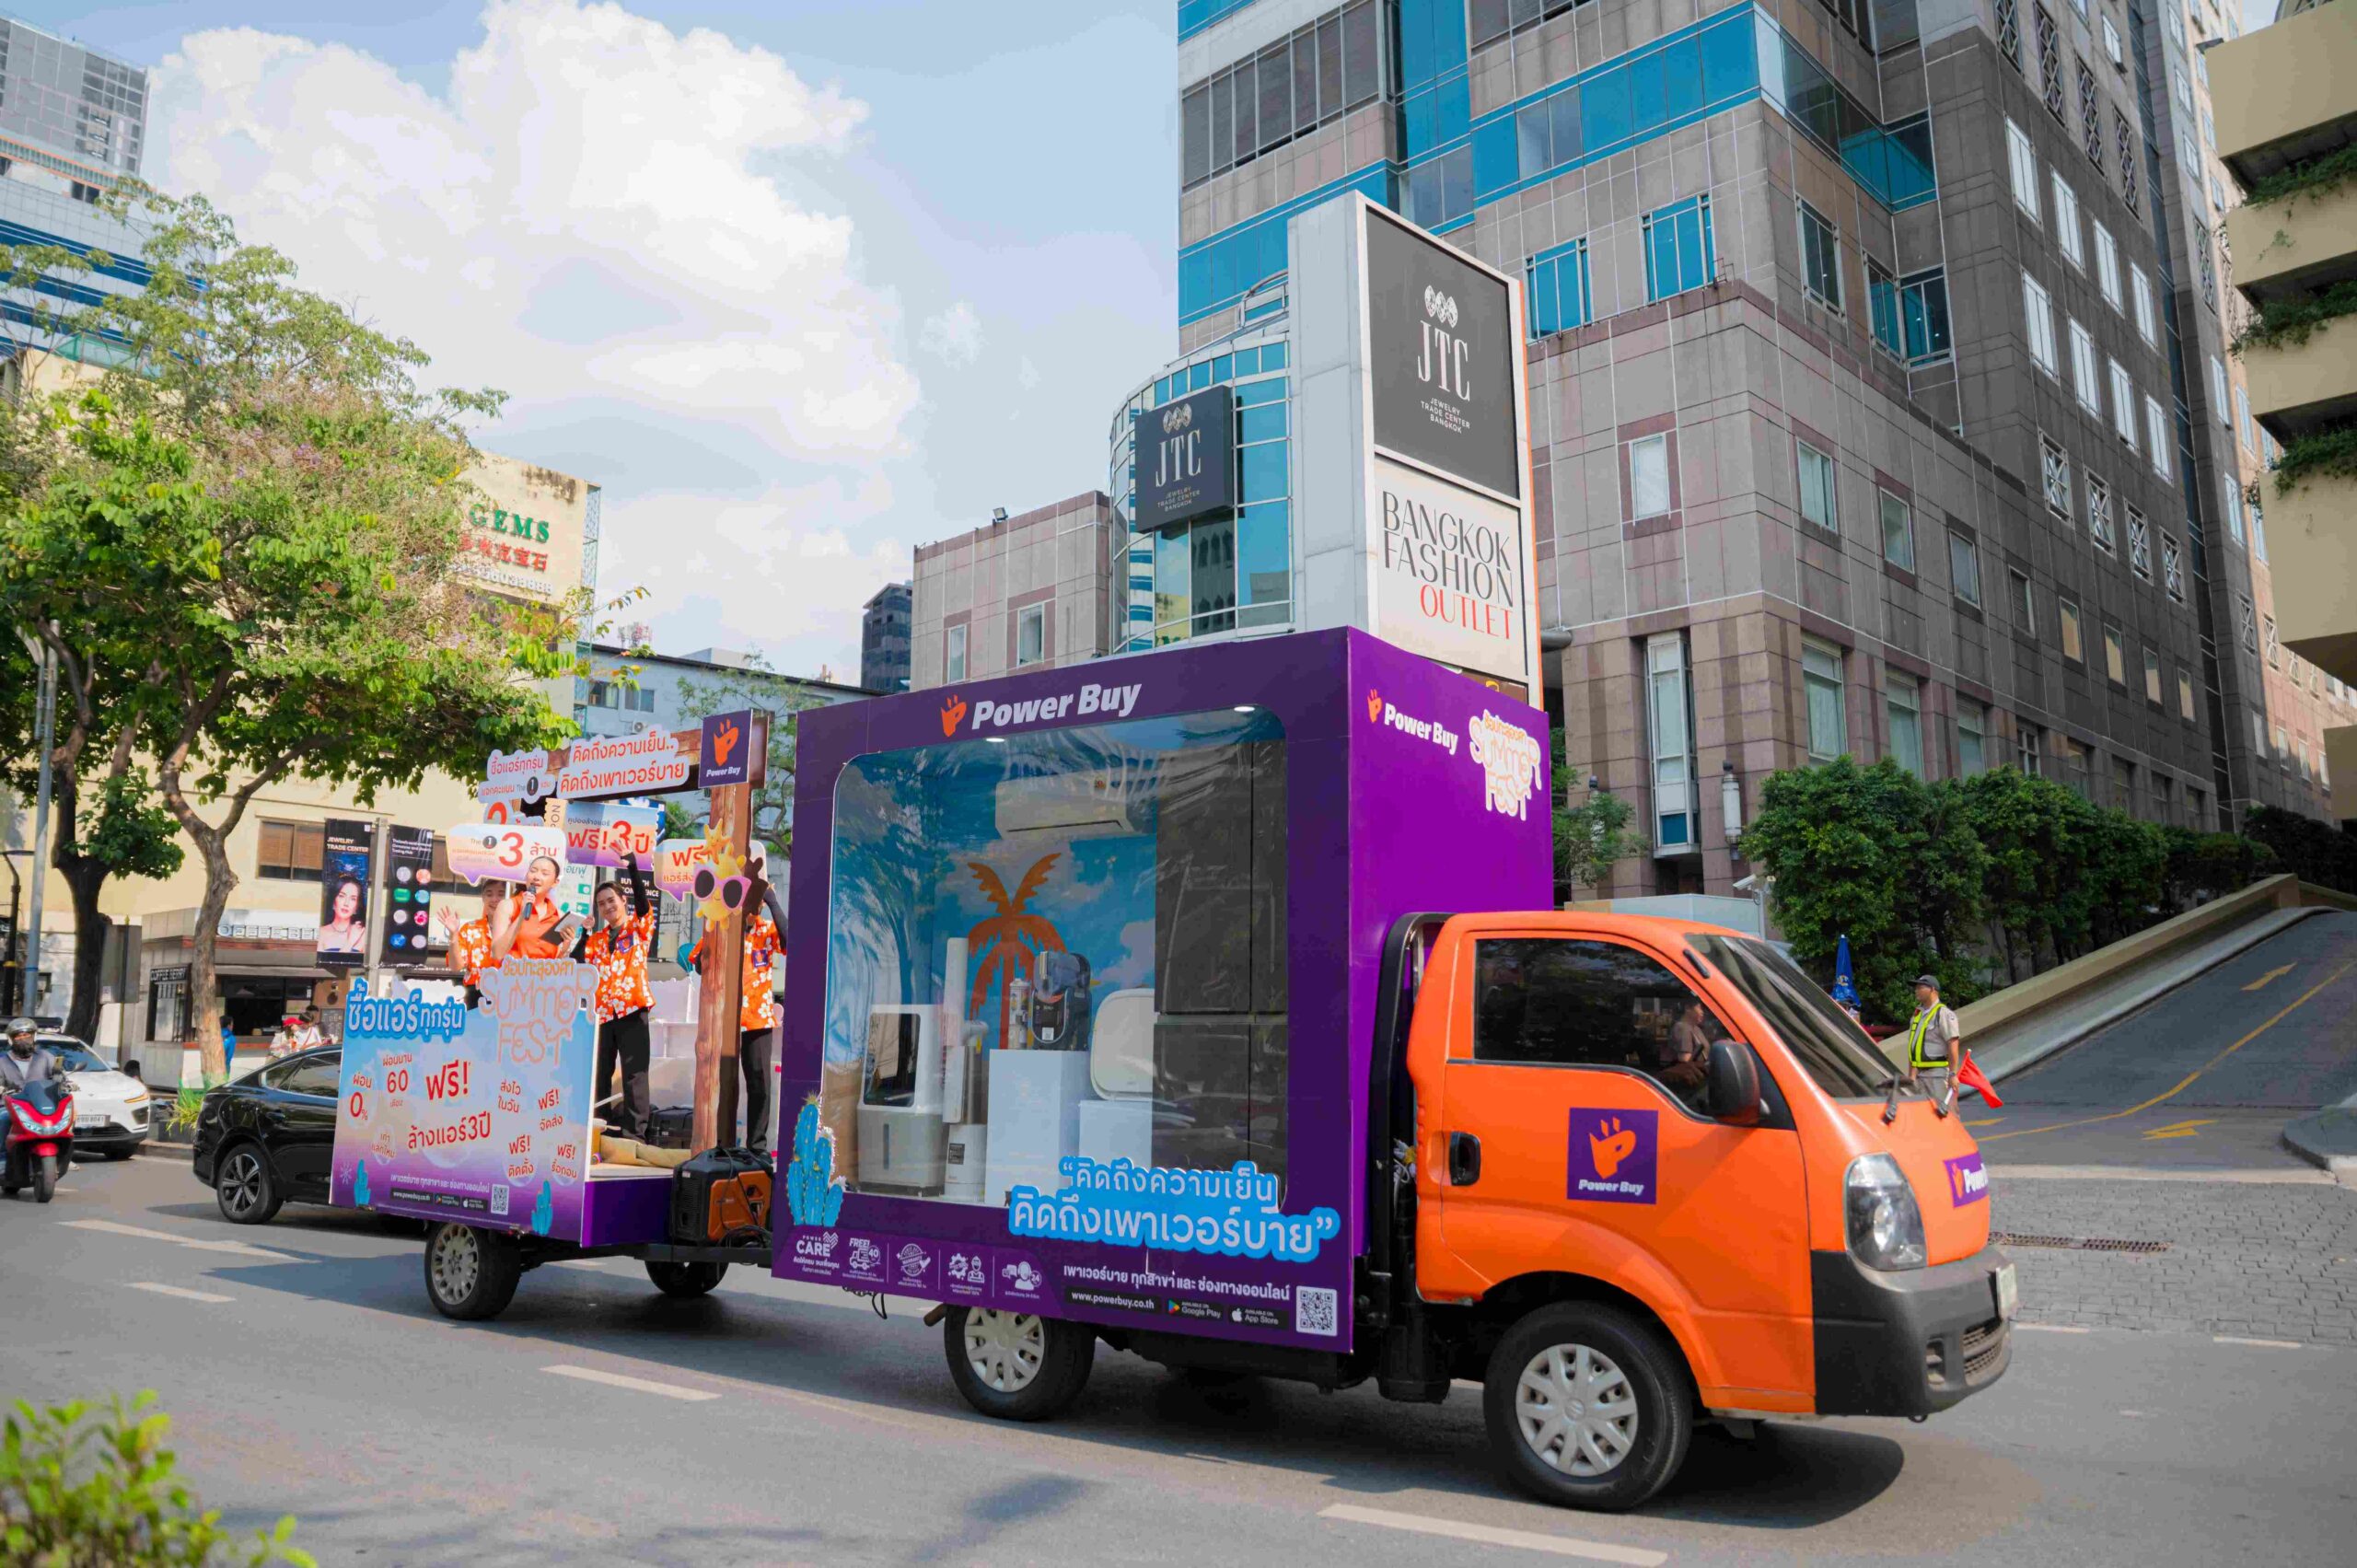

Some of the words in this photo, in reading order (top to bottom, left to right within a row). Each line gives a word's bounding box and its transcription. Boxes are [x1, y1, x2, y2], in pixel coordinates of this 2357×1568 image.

[1418, 319, 1470, 401] JTC
[1421, 401, 1443, 417] TRADE
[1446, 412, 1470, 429] CENTER
[1431, 398, 1460, 415] JEWELRY
[1430, 413, 1462, 434] BANGKOK
[1155, 429, 1202, 487] JTC
[469, 504, 550, 543] GEMS
[1383, 490, 1512, 572] BANGKOK
[1384, 529, 1514, 608] FASHION
[1420, 584, 1513, 640] OUTLET
[972, 692, 1074, 730] Power
[1077, 683, 1143, 717] Buy
[1384, 703, 1432, 740] Power
[1433, 721, 1458, 755] Buy
[706, 768, 727, 778] Power
[728, 765, 741, 777] Buy
[499, 831, 524, 866] 3
[568, 828, 608, 851] ฟรี!
[388, 1069, 408, 1094] 60
[426, 1059, 468, 1100] ฟรี!
[539, 1089, 560, 1110] ฟรี!
[509, 1134, 530, 1155] ฟรี!
[557, 1143, 575, 1160] ฟรี!
[1578, 1179, 1618, 1193] Power
[1619, 1181, 1644, 1196] Buy
[796, 1239, 830, 1257] CARE
[869, 1249, 878, 1258] 40
[1072, 1291, 1155, 1309] www.powerbuy.co.th
[1181, 1307, 1205, 1318] Google
[1206, 1309, 1222, 1319] Play
[1245, 1315, 1259, 1324] App
[1260, 1317, 1279, 1326] Store
